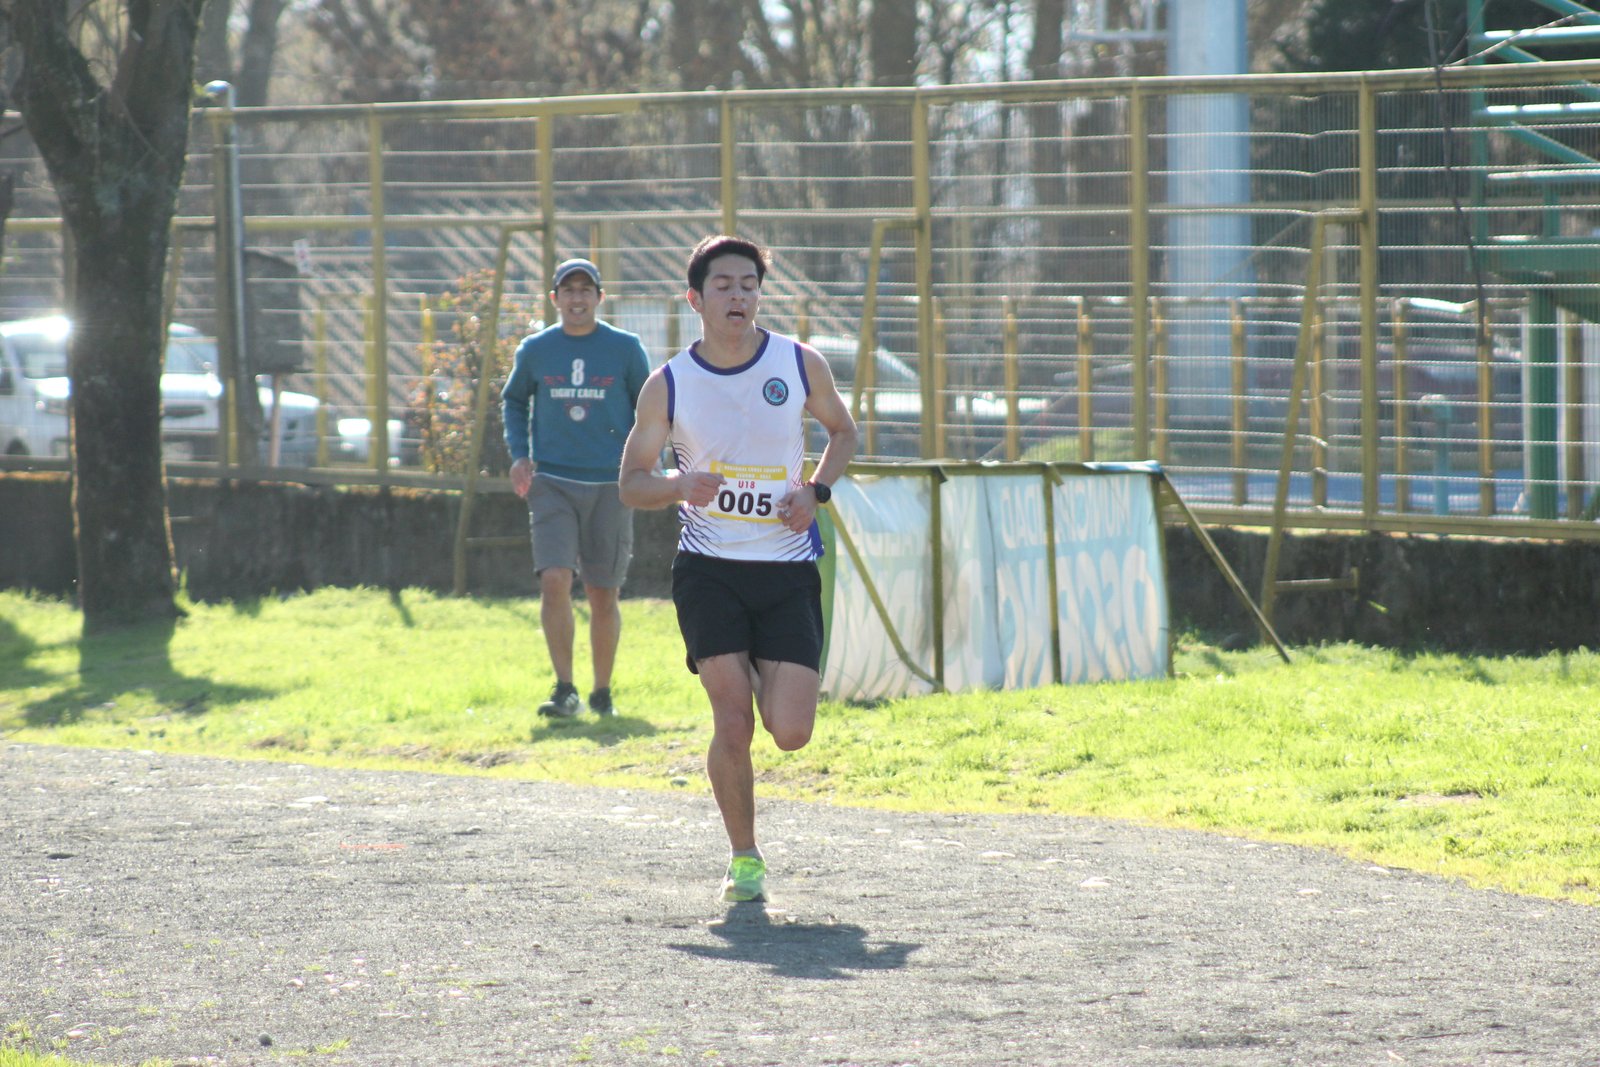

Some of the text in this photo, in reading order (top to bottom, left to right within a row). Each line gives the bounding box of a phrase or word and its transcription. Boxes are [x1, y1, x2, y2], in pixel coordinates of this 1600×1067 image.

[572, 359, 585, 386] 8
[738, 481, 756, 489] U18
[718, 490, 772, 516] 005
